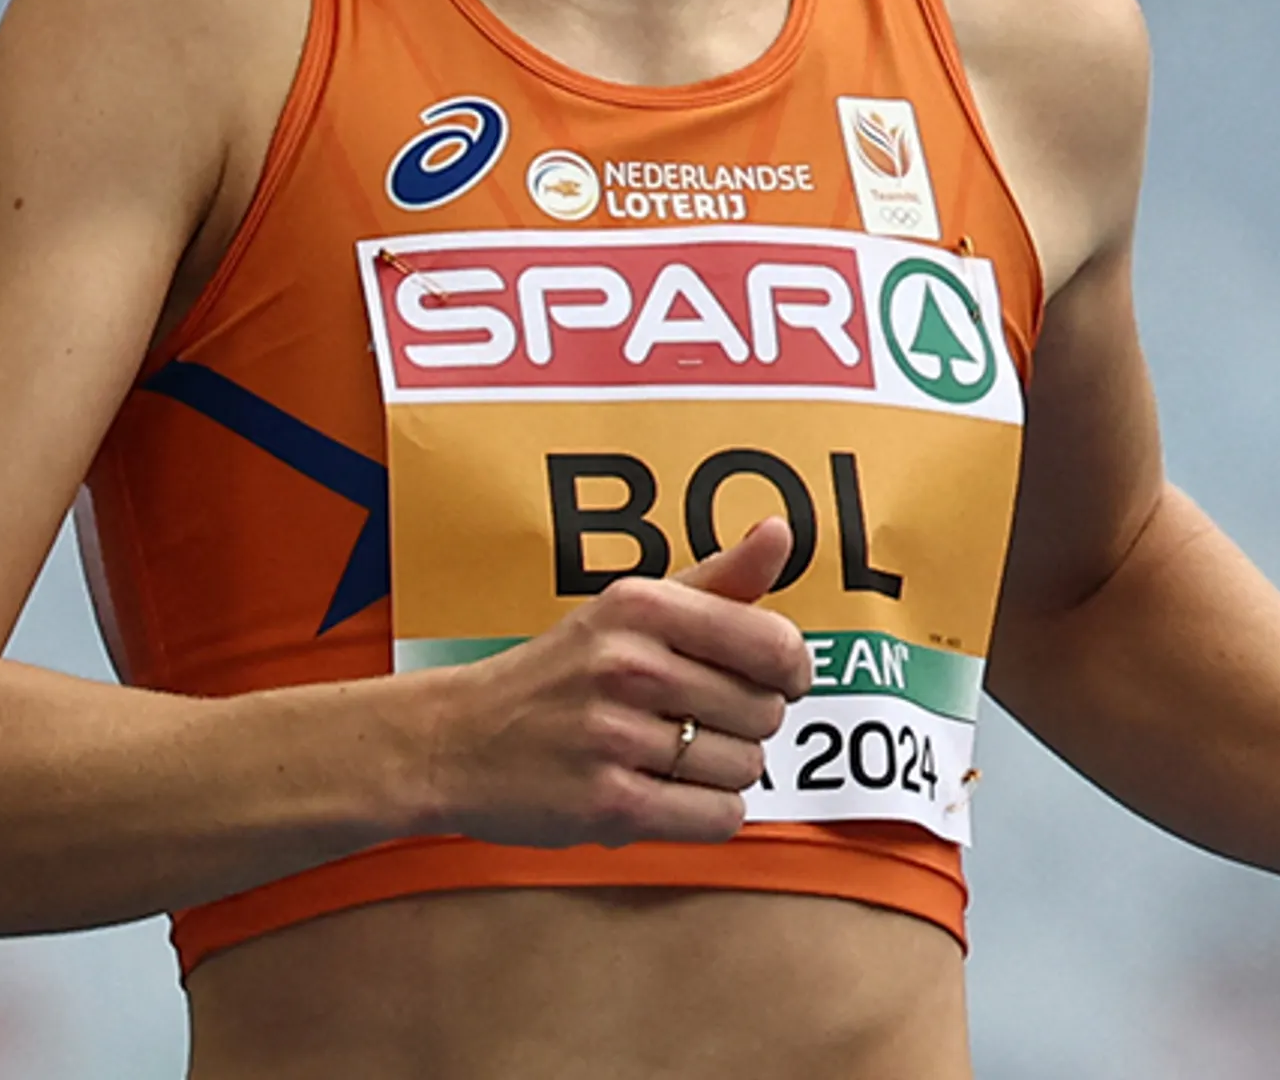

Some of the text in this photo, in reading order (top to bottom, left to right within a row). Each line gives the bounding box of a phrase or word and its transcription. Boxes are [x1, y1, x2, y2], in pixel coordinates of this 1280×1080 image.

[604, 161, 815, 191] NEDERLANDSE
[606, 192, 747, 220] LOTERIJ
[395, 262, 861, 368] SPAR
[546, 447, 903, 600] BOL
[795, 721, 938, 801] 2024
